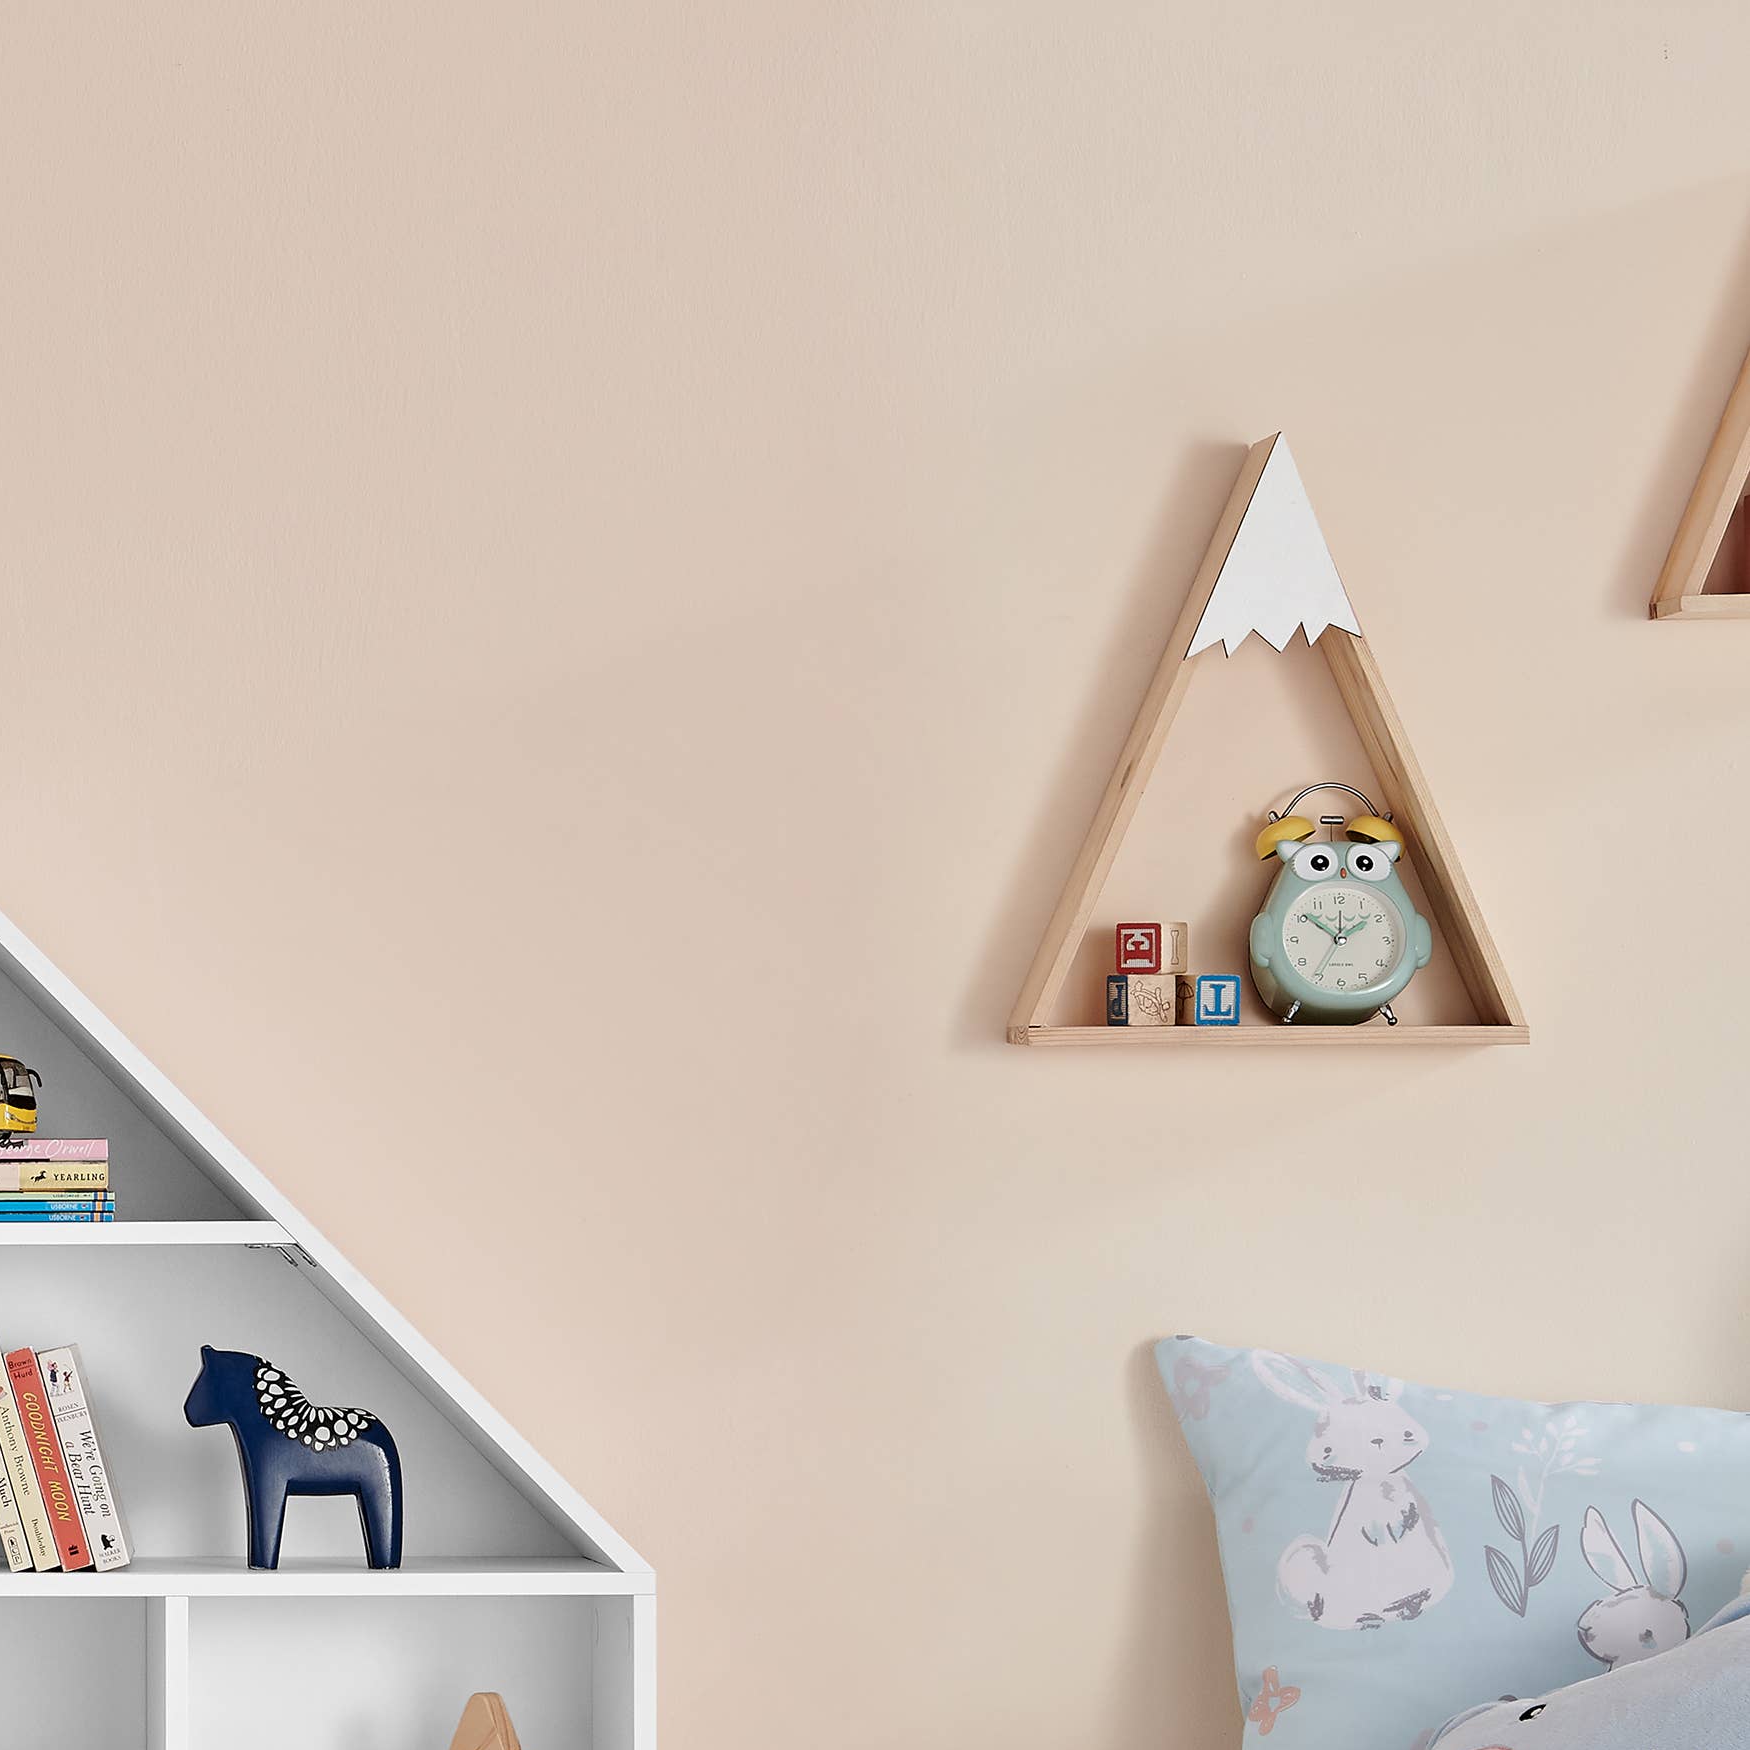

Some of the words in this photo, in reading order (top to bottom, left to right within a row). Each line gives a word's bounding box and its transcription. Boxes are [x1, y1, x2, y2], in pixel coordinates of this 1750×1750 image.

[1333, 896, 1346, 905] 12
[1313, 901, 1322, 910] 11
[1297, 914, 1308, 923] 10
[1374, 914, 1383, 923] 2
[1290, 936, 1299, 944] 9
[1382, 936, 1391, 945] 3
[1298, 957, 1307, 966] 8
[1375, 959, 1384, 967] 4
[1358, 972, 1368, 981] 5
[1336, 978, 1346, 987] 6
[1203, 983, 1231, 1016] T
[45, 1139, 96, 1158] Orwell
[53, 1172, 105, 1182] YEARLING
[8, 1358, 32, 1369] Brown
[13, 1369, 33, 1379] Hurd
[65, 1441, 75, 1449] a
[0, 1406, 18, 1452] Anthony
[14, 1455, 31, 1496] Browne
[23, 1392, 58, 1473] GOODNIGHT
[48, 1481, 72, 1522] MOON
[68, 1453, 84, 1480] Bear
[79, 1430, 97, 1461] We're
[89, 1465, 107, 1502] Going
[100, 1503, 111, 1517] on
[78, 1485, 95, 1515] Hunt
[31, 1518, 47, 1557] Doubleday
